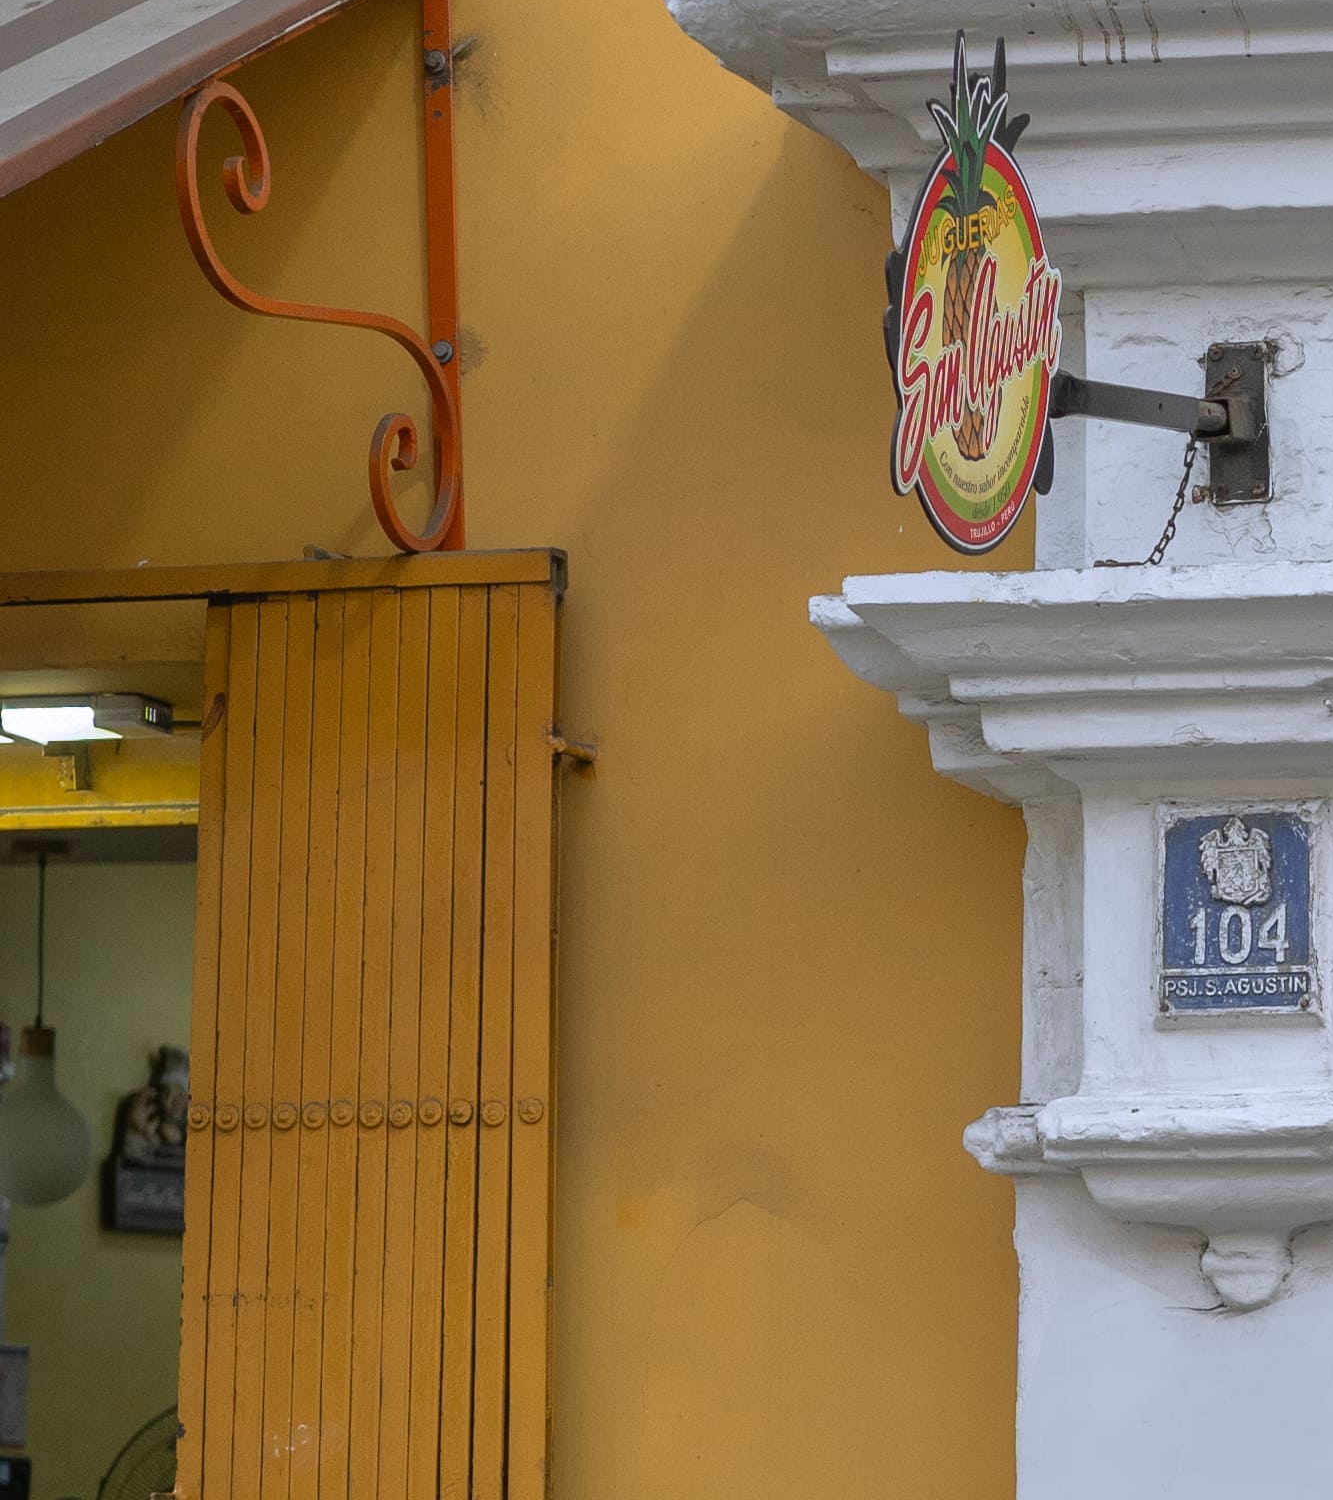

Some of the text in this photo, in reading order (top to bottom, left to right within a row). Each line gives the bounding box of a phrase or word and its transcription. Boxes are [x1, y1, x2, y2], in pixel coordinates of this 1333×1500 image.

[918, 184, 1018, 278] JUGUERIAS
[901, 288, 965, 488] San
[953, 476, 978, 495] nuestro
[978, 472, 997, 494] sabor
[997, 395, 1030, 482] incomparable
[970, 523, 996, 540] TRUJILLO
[1189, 905, 1289, 965] 104
